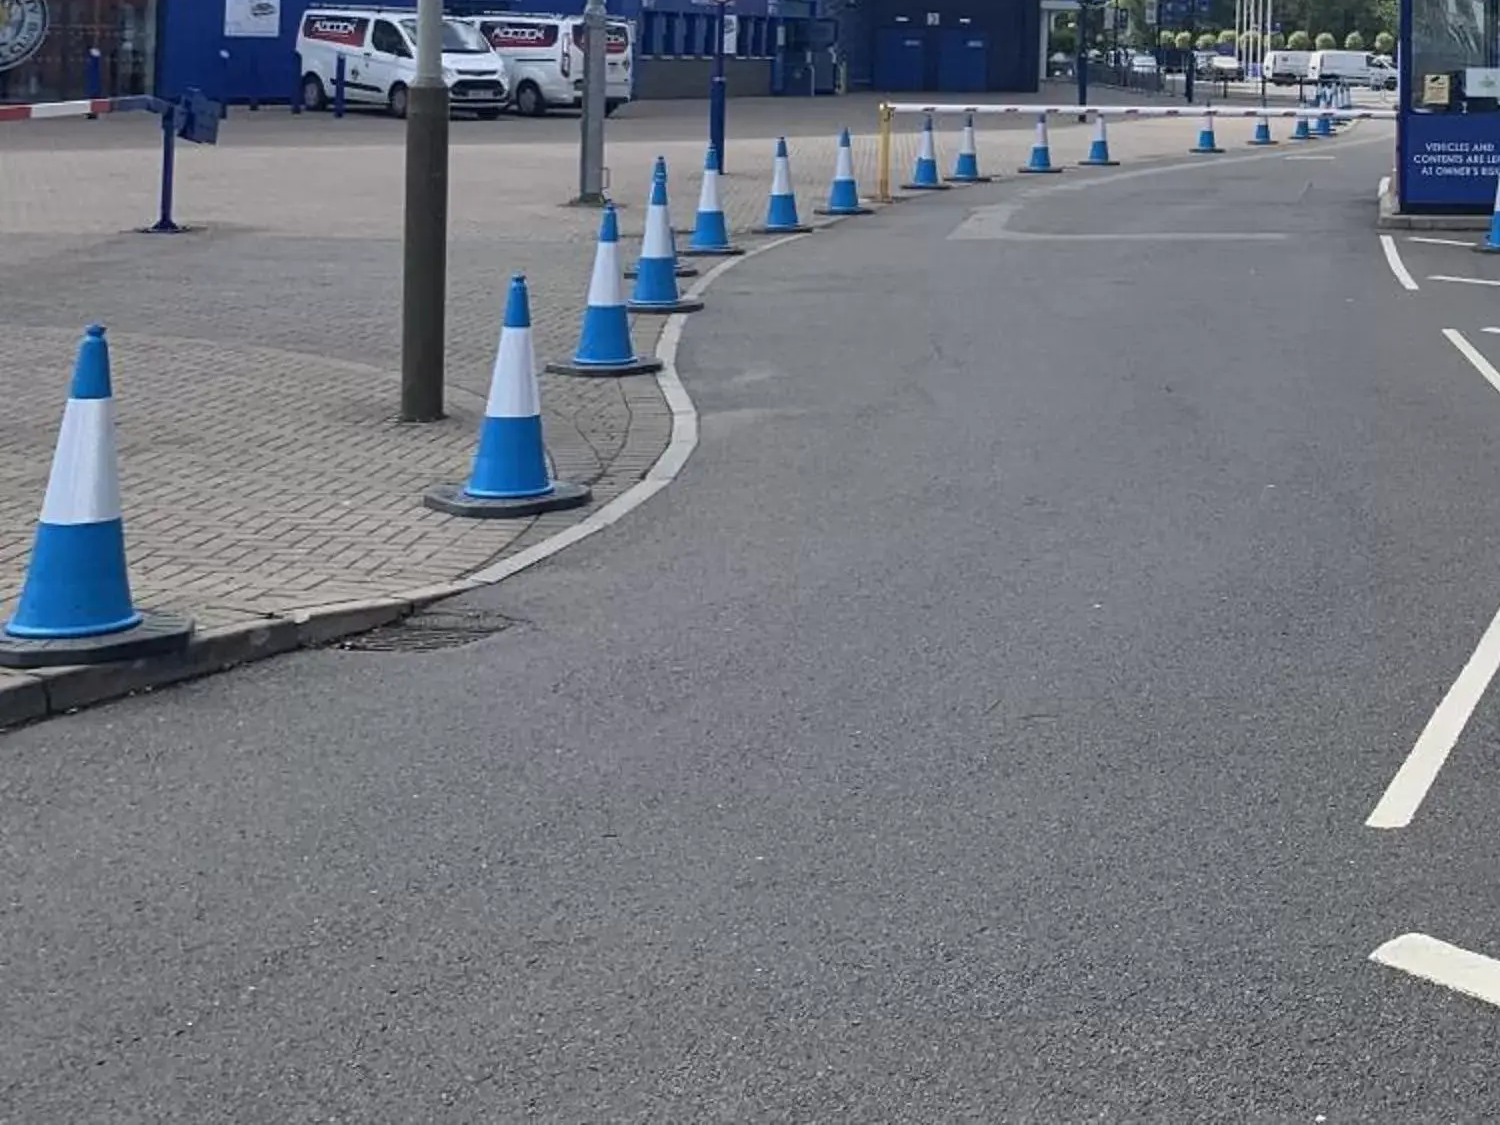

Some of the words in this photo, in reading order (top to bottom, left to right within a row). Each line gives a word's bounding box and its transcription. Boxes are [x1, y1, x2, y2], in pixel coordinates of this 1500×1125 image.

[1425, 142, 1470, 152] VEHICLES
[1471, 142, 1495, 152] AND
[1413, 154, 1463, 164] CONTENTS
[1466, 155, 1485, 164] ARE
[1421, 166, 1433, 175] AT
